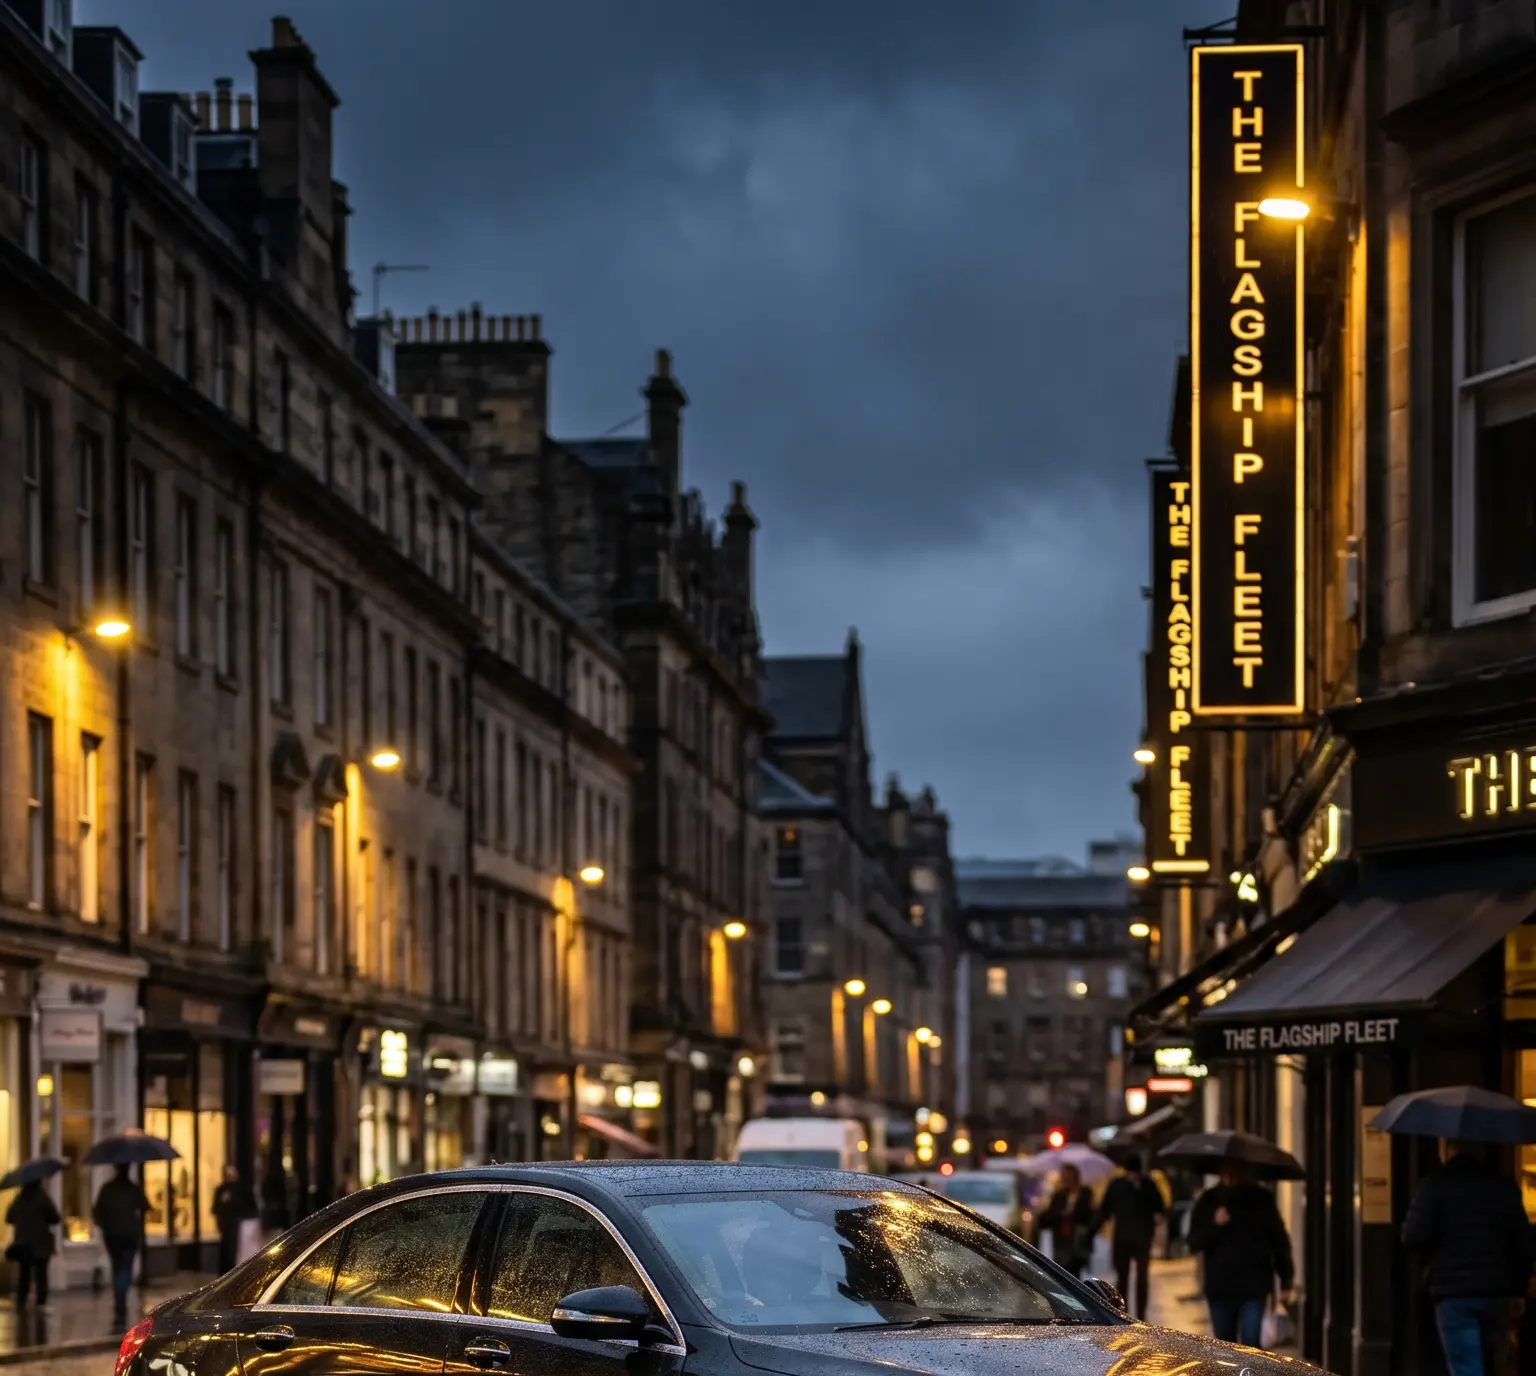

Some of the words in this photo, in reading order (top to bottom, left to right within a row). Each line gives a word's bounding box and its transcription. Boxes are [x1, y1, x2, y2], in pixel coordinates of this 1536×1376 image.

[1232, 70, 1263, 174] THE
[1230, 202, 1265, 484] FLAGSHIP
[1169, 481, 1191, 547] THE
[1168, 559, 1191, 733] FLAGSHIP
[1233, 514, 1263, 688] FLEET
[1169, 745, 1191, 857] FLEET
[1223, 1028, 1256, 1050] THE
[1260, 1022, 1342, 1048] FLAGSHIP
[1345, 1018, 1399, 1043] FLEET
